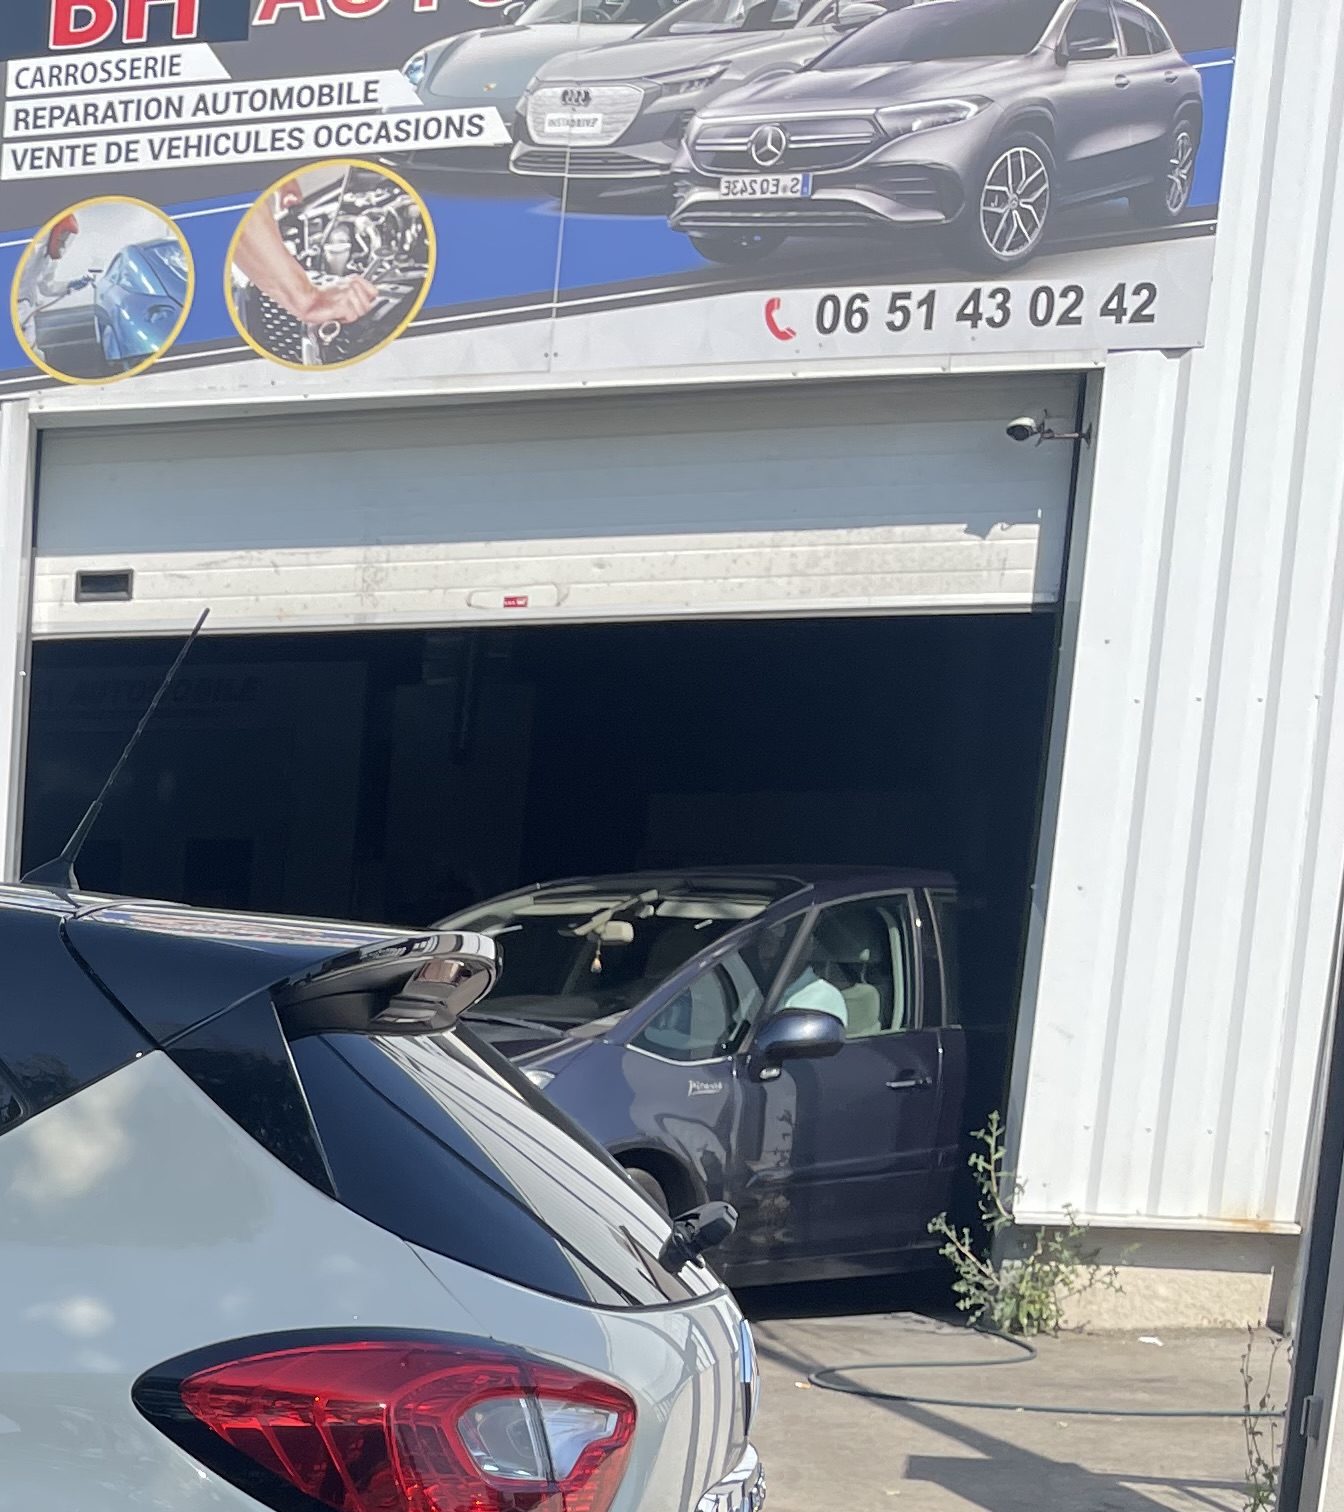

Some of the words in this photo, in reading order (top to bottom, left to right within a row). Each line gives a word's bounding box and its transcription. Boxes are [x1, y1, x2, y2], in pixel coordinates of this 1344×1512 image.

[14, 53, 182, 90] CARROSSERIE
[13, 96, 185, 133] REPARATION
[191, 79, 380, 116] AUTOMOBILE
[11, 143, 99, 172] VENTE
[104, 139, 140, 165] DE
[147, 128, 304, 163] VEHICULES
[313, 113, 485, 149] OCCASIONS
[815, 293, 869, 335] 06
[885, 289, 937, 333] 51
[955, 287, 1012, 330] 43
[1029, 284, 1084, 328] 02
[1099, 281, 1157, 325] 42
